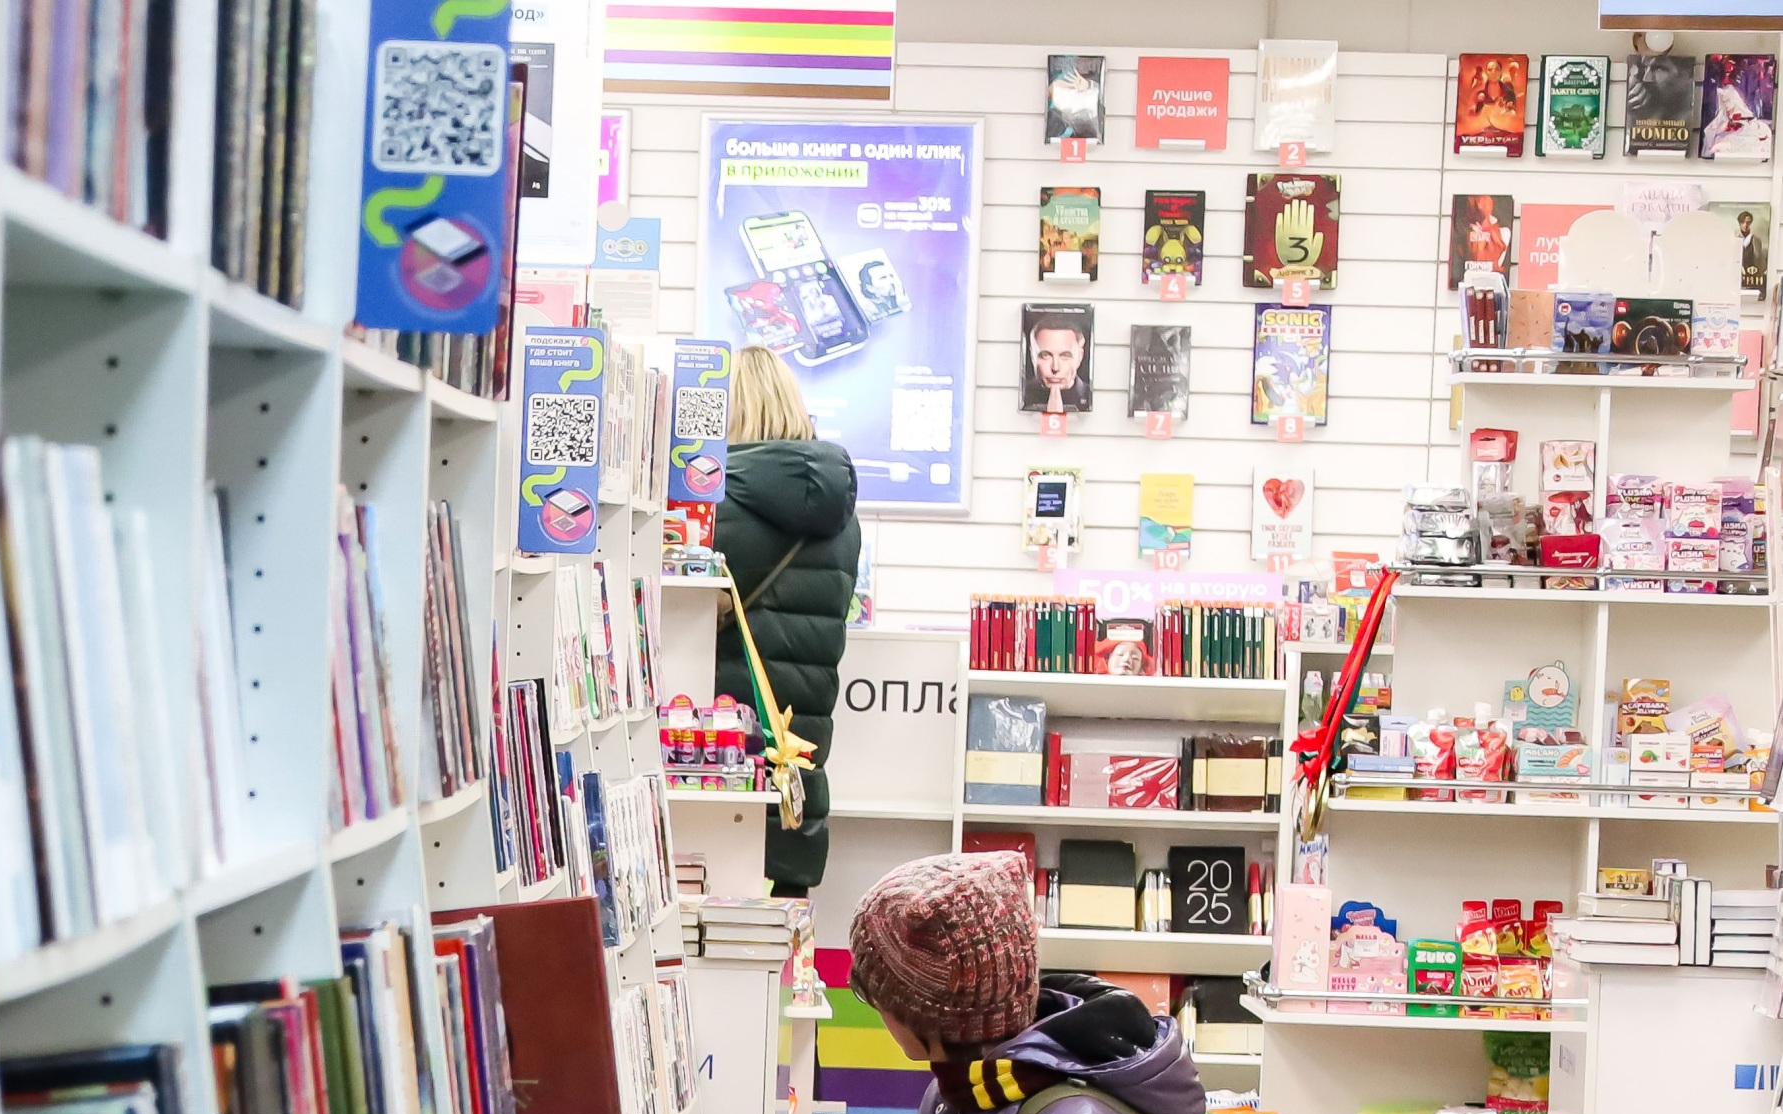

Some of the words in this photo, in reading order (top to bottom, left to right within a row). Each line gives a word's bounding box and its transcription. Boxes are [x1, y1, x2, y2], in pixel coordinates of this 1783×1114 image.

[1153, 89, 1213, 105] лучшие
[1147, 105, 1217, 119] продажи
[1631, 127, 1689, 140] РОМЕО
[725, 138, 800, 156] больше
[802, 143, 847, 157] книг
[850, 144, 862, 157] в
[864, 143, 913, 160] один
[1070, 140, 1079, 157] 1
[1286, 143, 1300, 160] 2
[726, 165, 736, 176] в
[741, 165, 861, 180] приложении
[1286, 236, 1309, 263] 3
[1167, 277, 1179, 294] 4
[1291, 282, 1303, 298] 5
[1265, 311, 1321, 326] SONIC
[530, 348, 546, 356] где
[547, 348, 573, 357] стоит
[554, 359, 581, 368] книга
[1048, 414, 1061, 430] 6
[1154, 413, 1165, 430] 7
[1284, 418, 1296, 433] 8
[1046, 547, 1058, 563] 9
[1157, 552, 1179, 568] 10
[1273, 555, 1289, 570] 11
[1160, 581, 1186, 595] на
[1189, 582, 1267, 598] вторую
[1186, 859, 1233, 892] 20
[1186, 892, 1233, 925] 25
[1415, 950, 1457, 964] ZUKO
